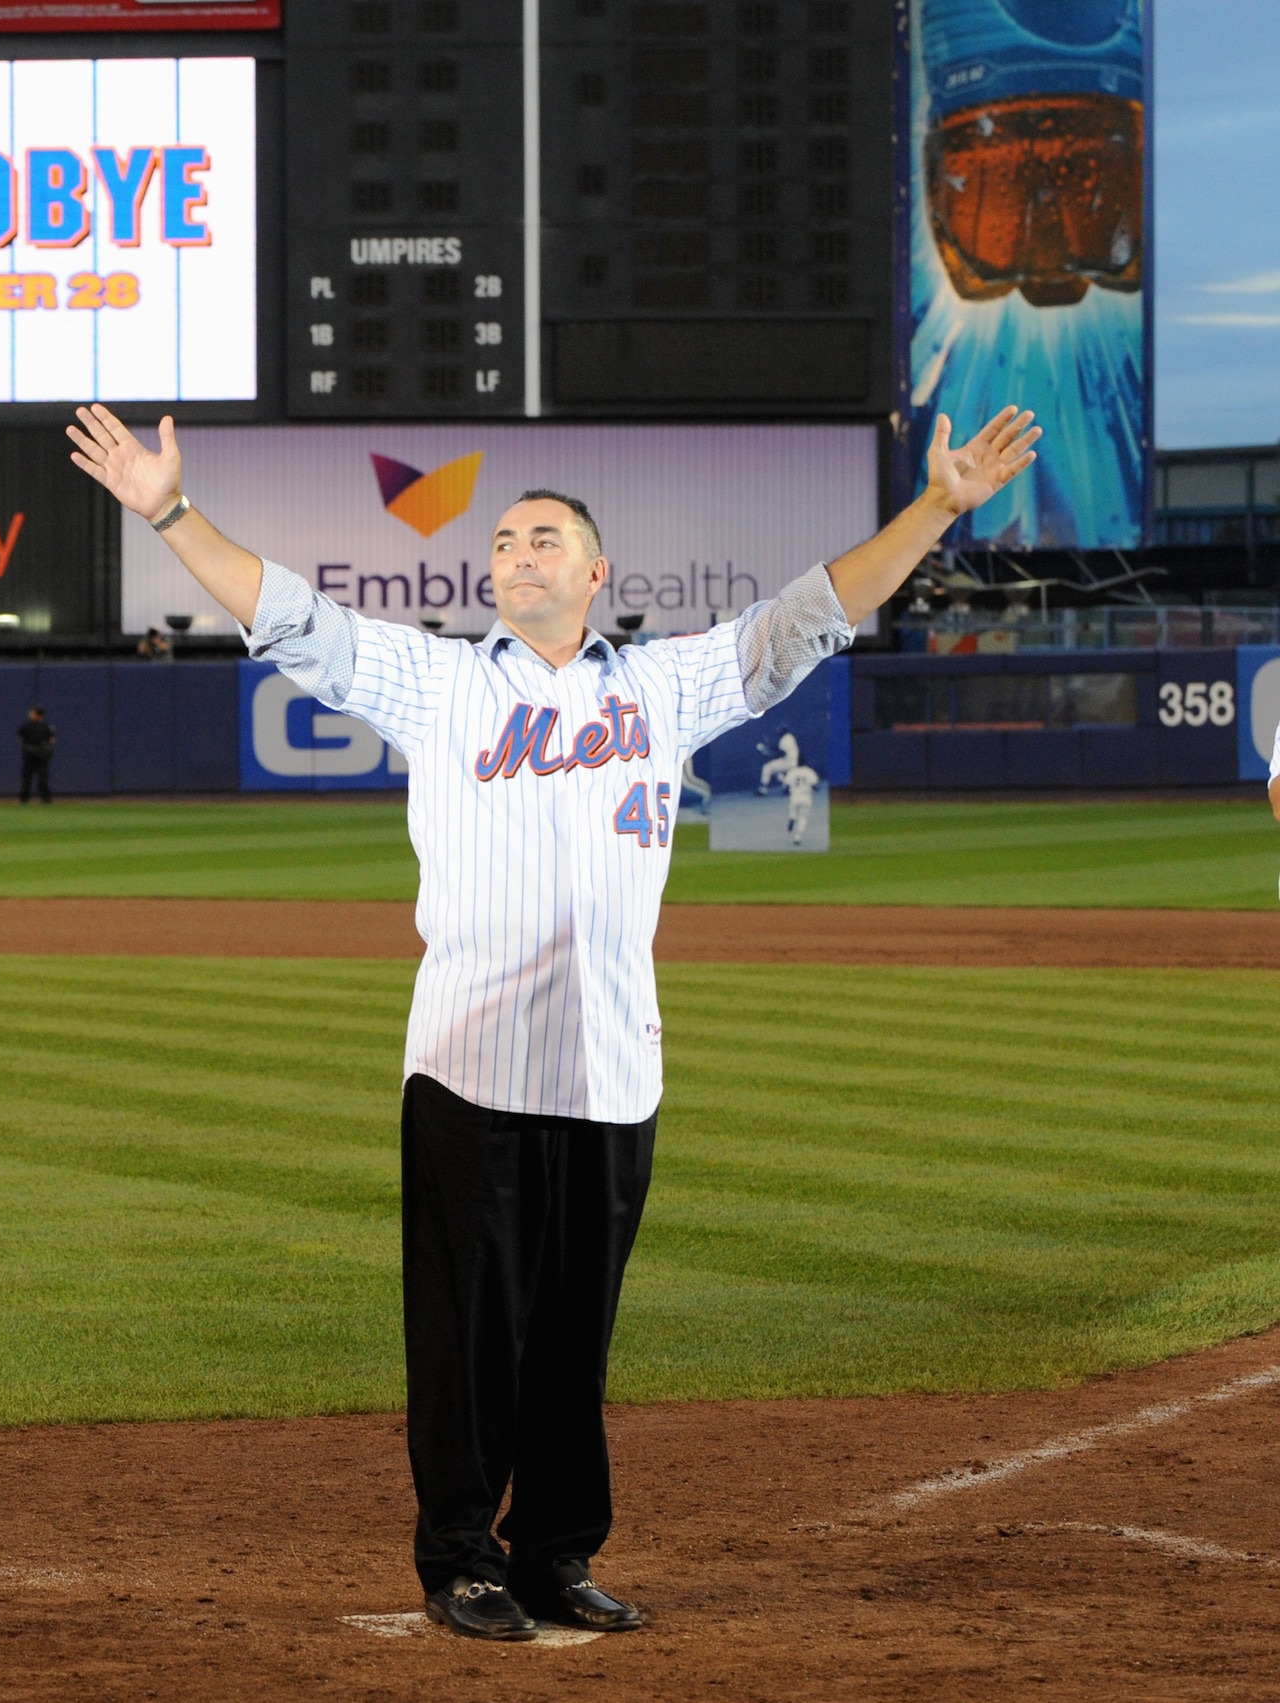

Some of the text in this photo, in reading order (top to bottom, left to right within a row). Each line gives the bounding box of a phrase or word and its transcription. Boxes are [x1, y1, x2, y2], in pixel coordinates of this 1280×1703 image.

[350, 236, 462, 265] UMPIRES
[66, 272, 141, 311] 28
[310, 276, 336, 299] PL
[474, 275, 502, 298] 2B
[309, 323, 334, 346] 1B
[474, 322, 502, 345] 3B
[310, 370, 337, 394] RF
[475, 369, 501, 393] LF
[1158, 680, 1236, 727] 358
[474, 694, 650, 782] Mets
[613, 781, 670, 848] 45
